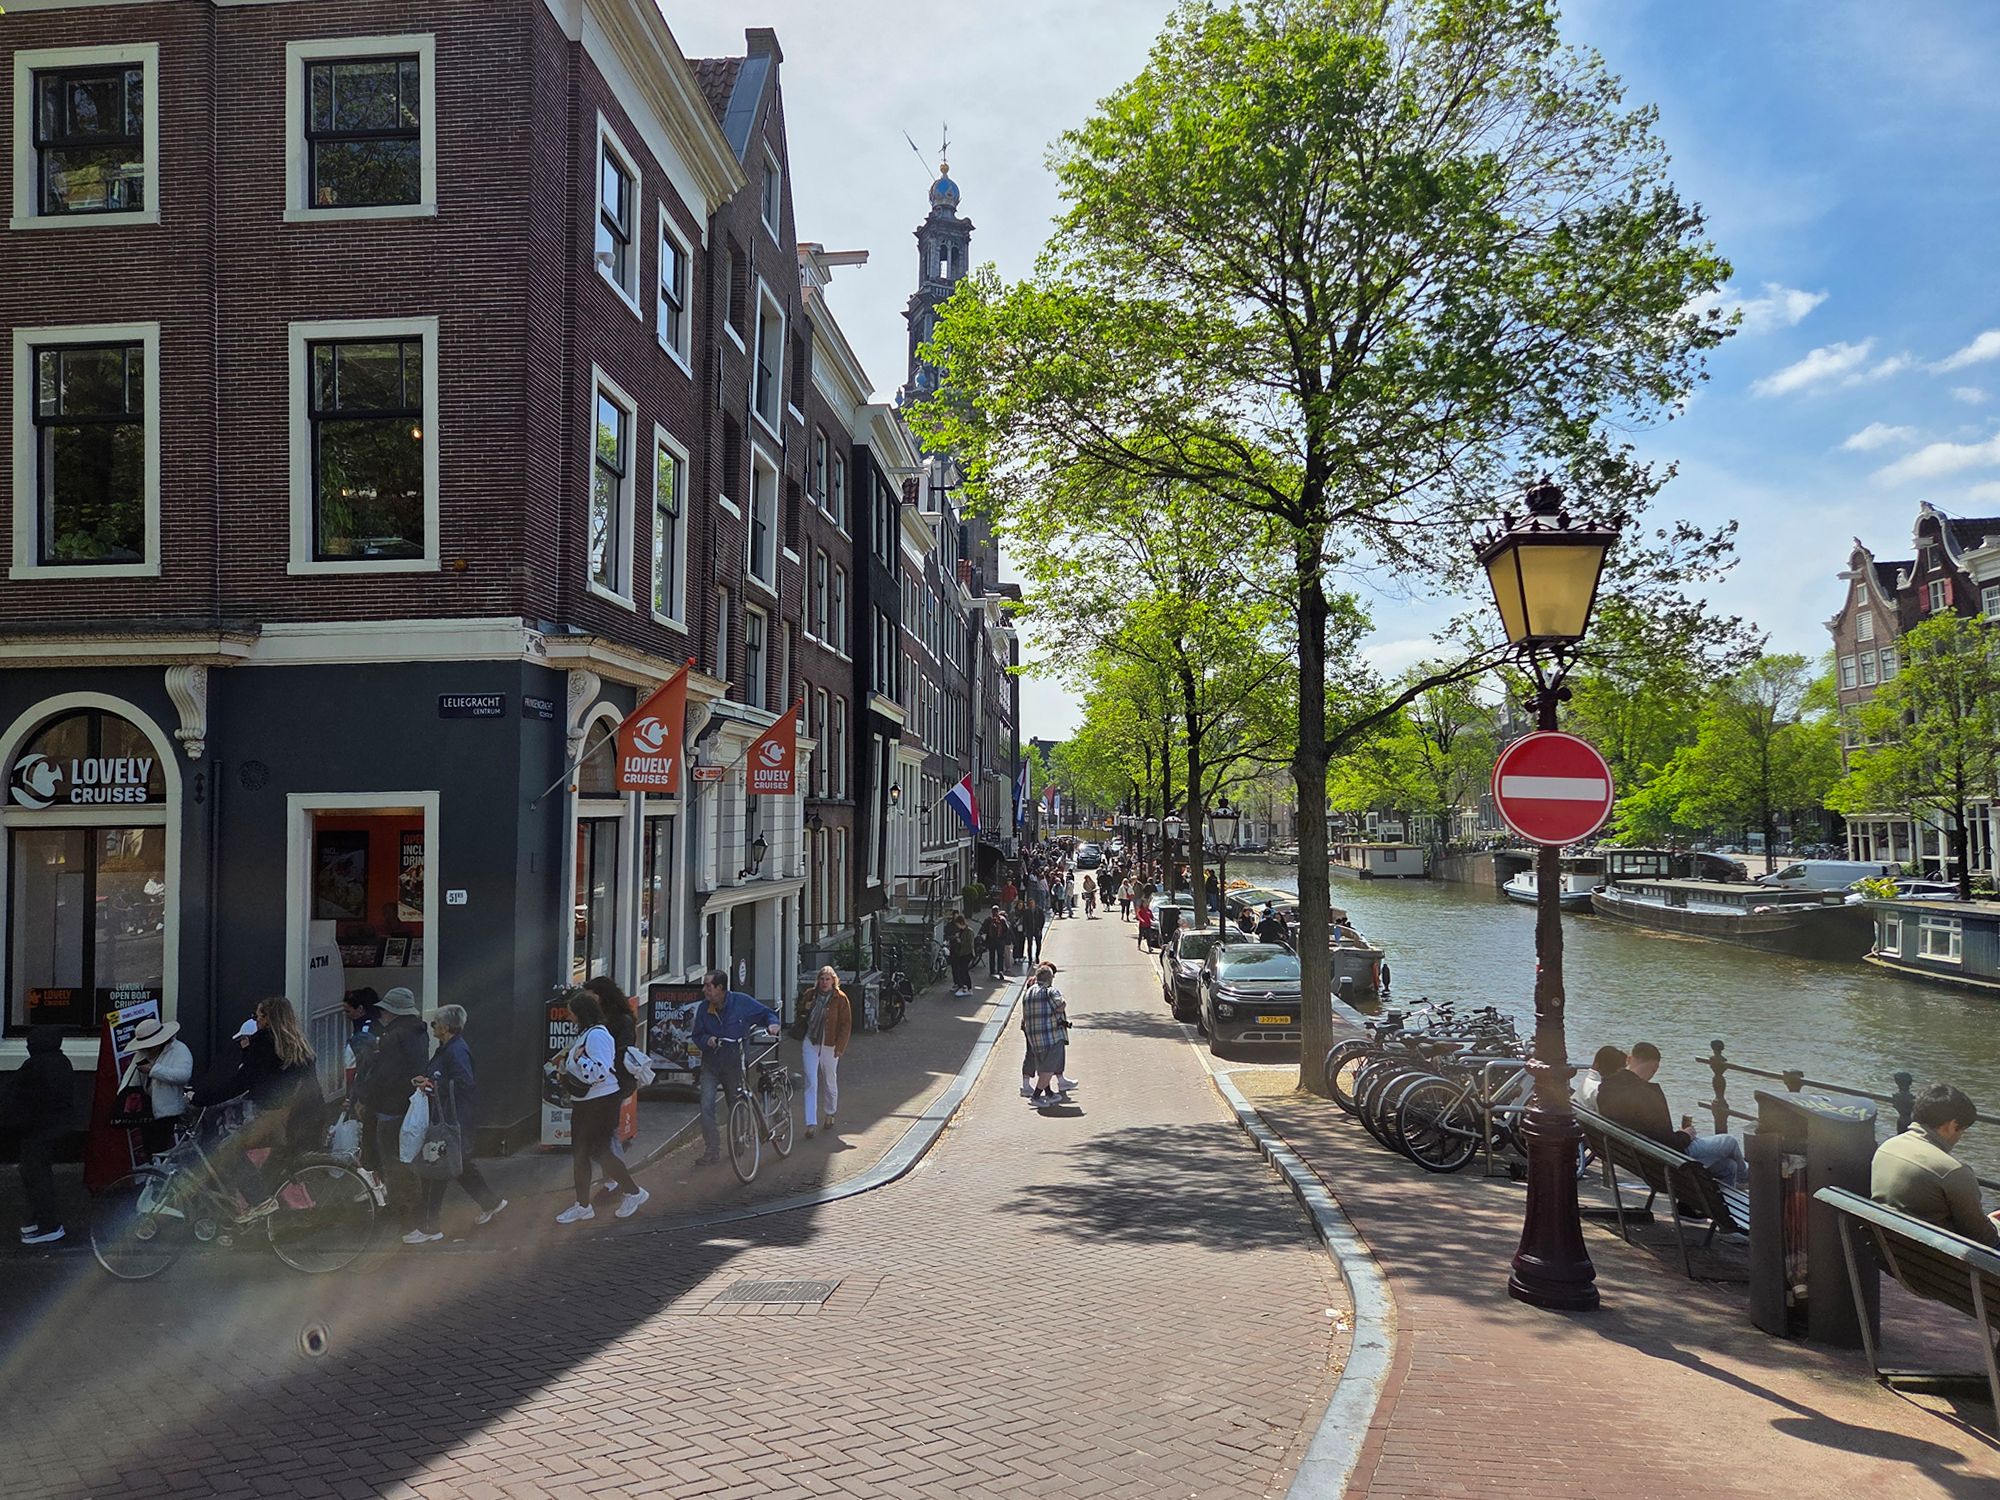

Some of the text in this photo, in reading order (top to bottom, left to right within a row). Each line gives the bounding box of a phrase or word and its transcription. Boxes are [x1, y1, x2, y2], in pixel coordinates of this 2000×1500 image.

[443, 697, 500, 707] LELIEGRACHT
[624, 756, 672, 773] LOVELY
[71, 758, 152, 784] LOVELY
[754, 769, 790, 782] LOVELY
[623, 774, 669, 784] CRUISES
[70, 787, 147, 803] CRUISES
[310, 955, 329, 969] ATM
[115, 982, 145, 991] LUXURY
[110, 990, 151, 1000] OPEN BOAT
[655, 1010, 685, 1020] DRINKS
